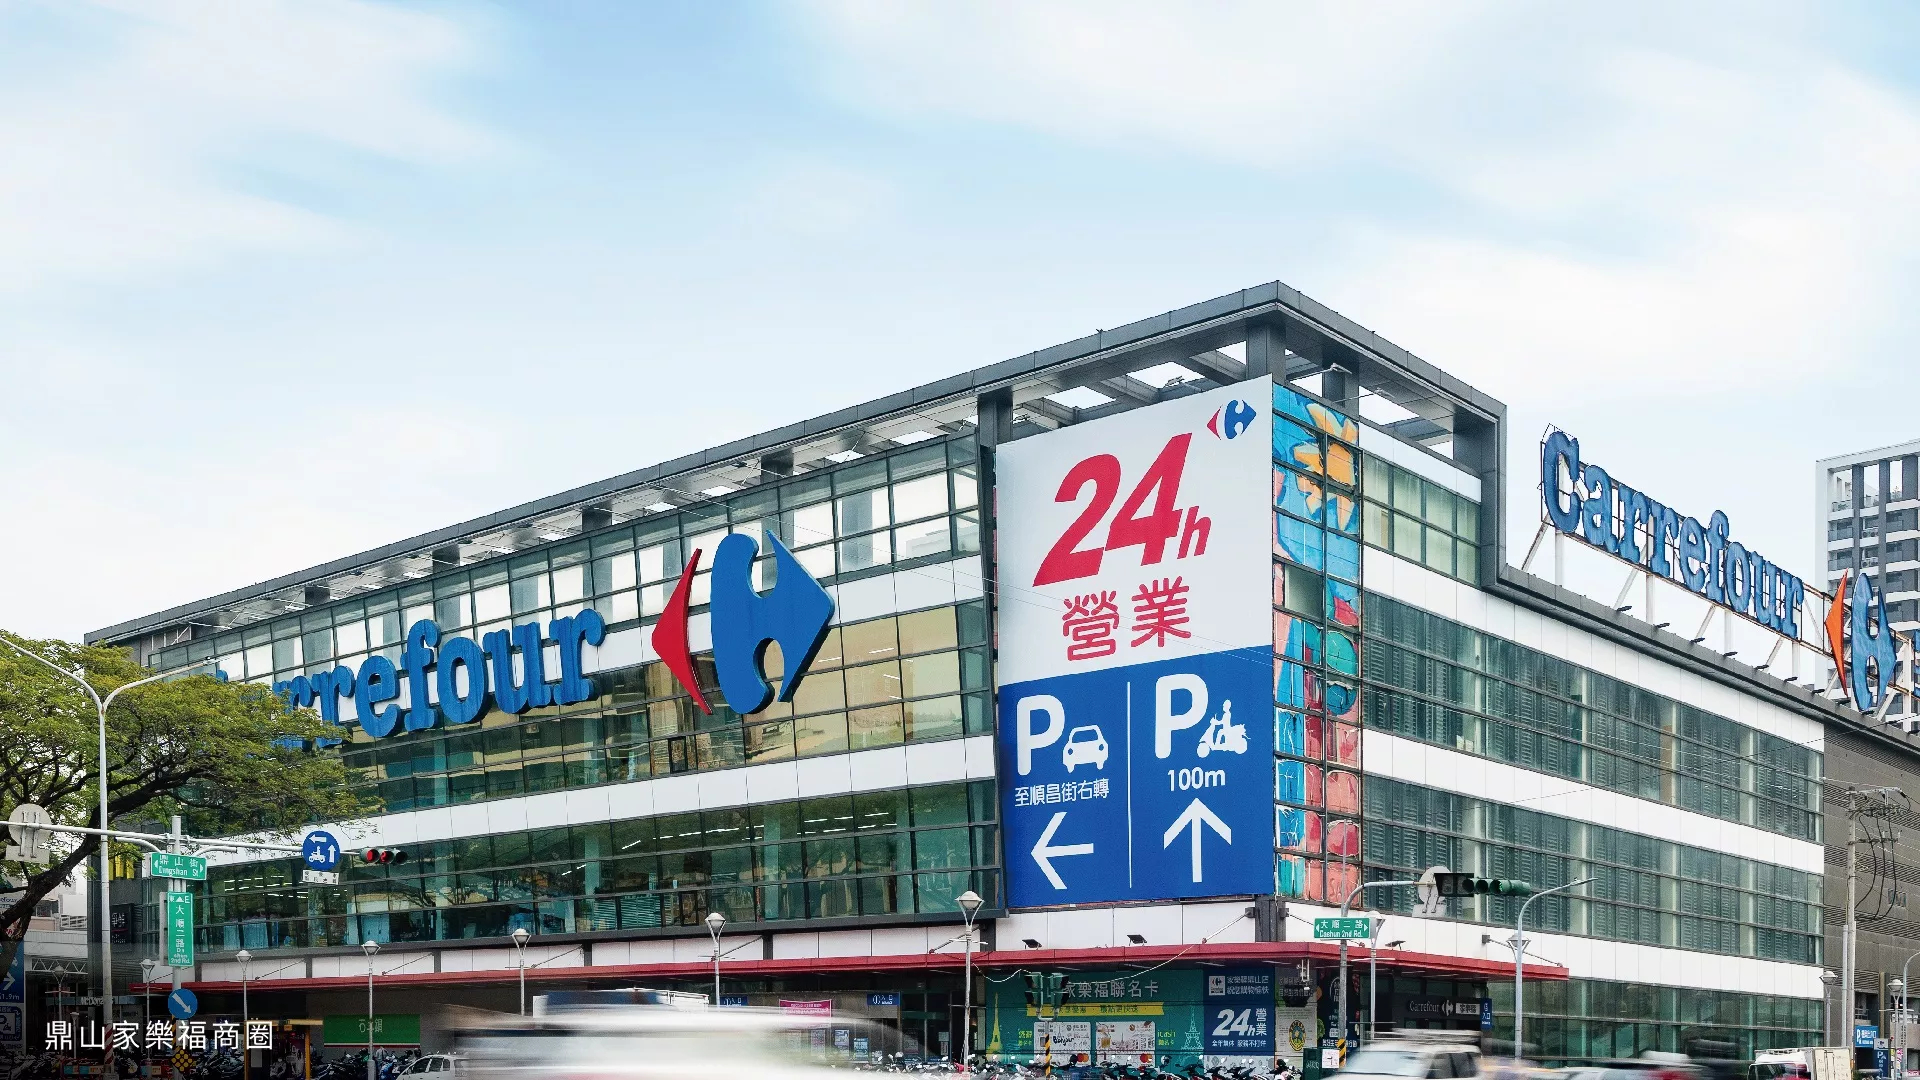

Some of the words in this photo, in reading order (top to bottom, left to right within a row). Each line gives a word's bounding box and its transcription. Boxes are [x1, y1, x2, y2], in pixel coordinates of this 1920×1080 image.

[1033, 433, 1212, 587] 24h
[1543, 431, 1805, 641] Carrefour
[1063, 576, 1192, 661] 營業
[213, 608, 607, 752] rrefour
[1155, 673, 1209, 759] P
[1017, 695, 1065, 776] P
[1014, 778, 1110, 807] 至順昌街右轉
[1167, 766, 1226, 792] 100m
[159, 854, 199, 868] 鼎山街
[184, 895, 191, 904] E
[175, 904, 185, 948] 大順二路
[1320, 920, 1363, 929] 大順二路
[1255, 1007, 1268, 1036] 營業
[1409, 1001, 1439, 1013] Carrefour
[1212, 1008, 1256, 1036] 24h
